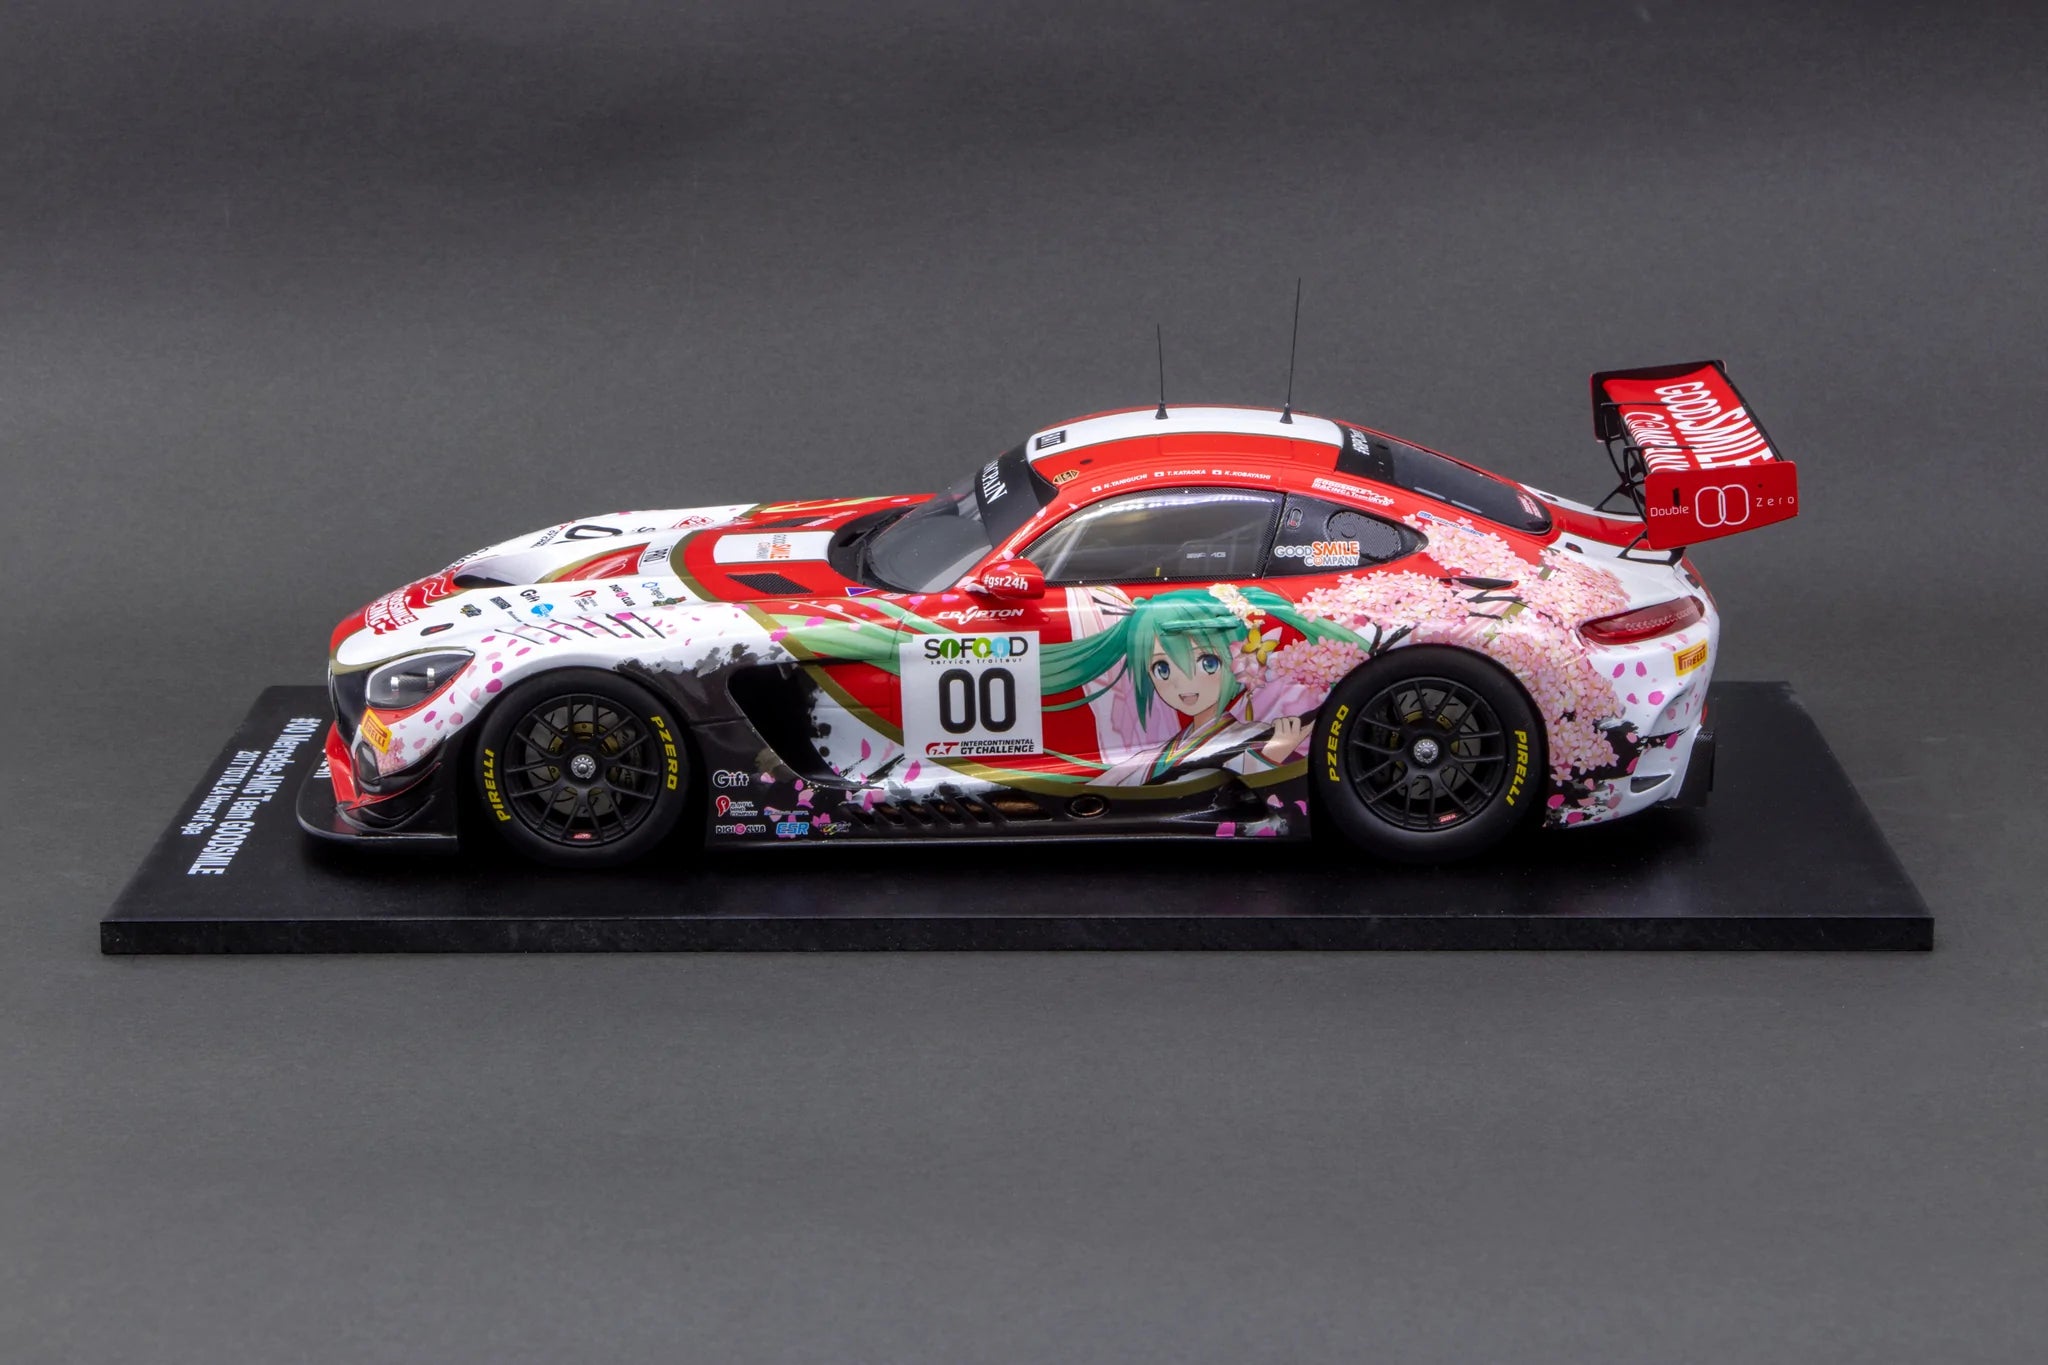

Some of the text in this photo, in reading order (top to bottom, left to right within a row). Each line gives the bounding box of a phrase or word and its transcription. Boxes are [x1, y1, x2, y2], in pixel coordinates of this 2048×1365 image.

[1650, 505, 1689, 517] Double
[1755, 496, 1795, 508] Zero
[983, 575, 1029, 591] #gsr24h
[976, 657, 1022, 665] traiteur
[1677, 647, 1707, 672] PIRELLI
[938, 667, 1017, 734] 00
[960, 738, 1035, 747] INTERCONTINENTAL
[960, 744, 1035, 755] GT CHALLENGE
[713, 769, 750, 788] Gift
[1505, 729, 1529, 807] PIRELLI
[180, 750, 261, 835] 2017 TOTAL 24 Hours of Spa
[483, 748, 512, 823] PIRELLI
[187, 718, 322, 875] #00 Mercedes-AMG Team GOODSMILE
[776, 821, 810, 836] ESR
